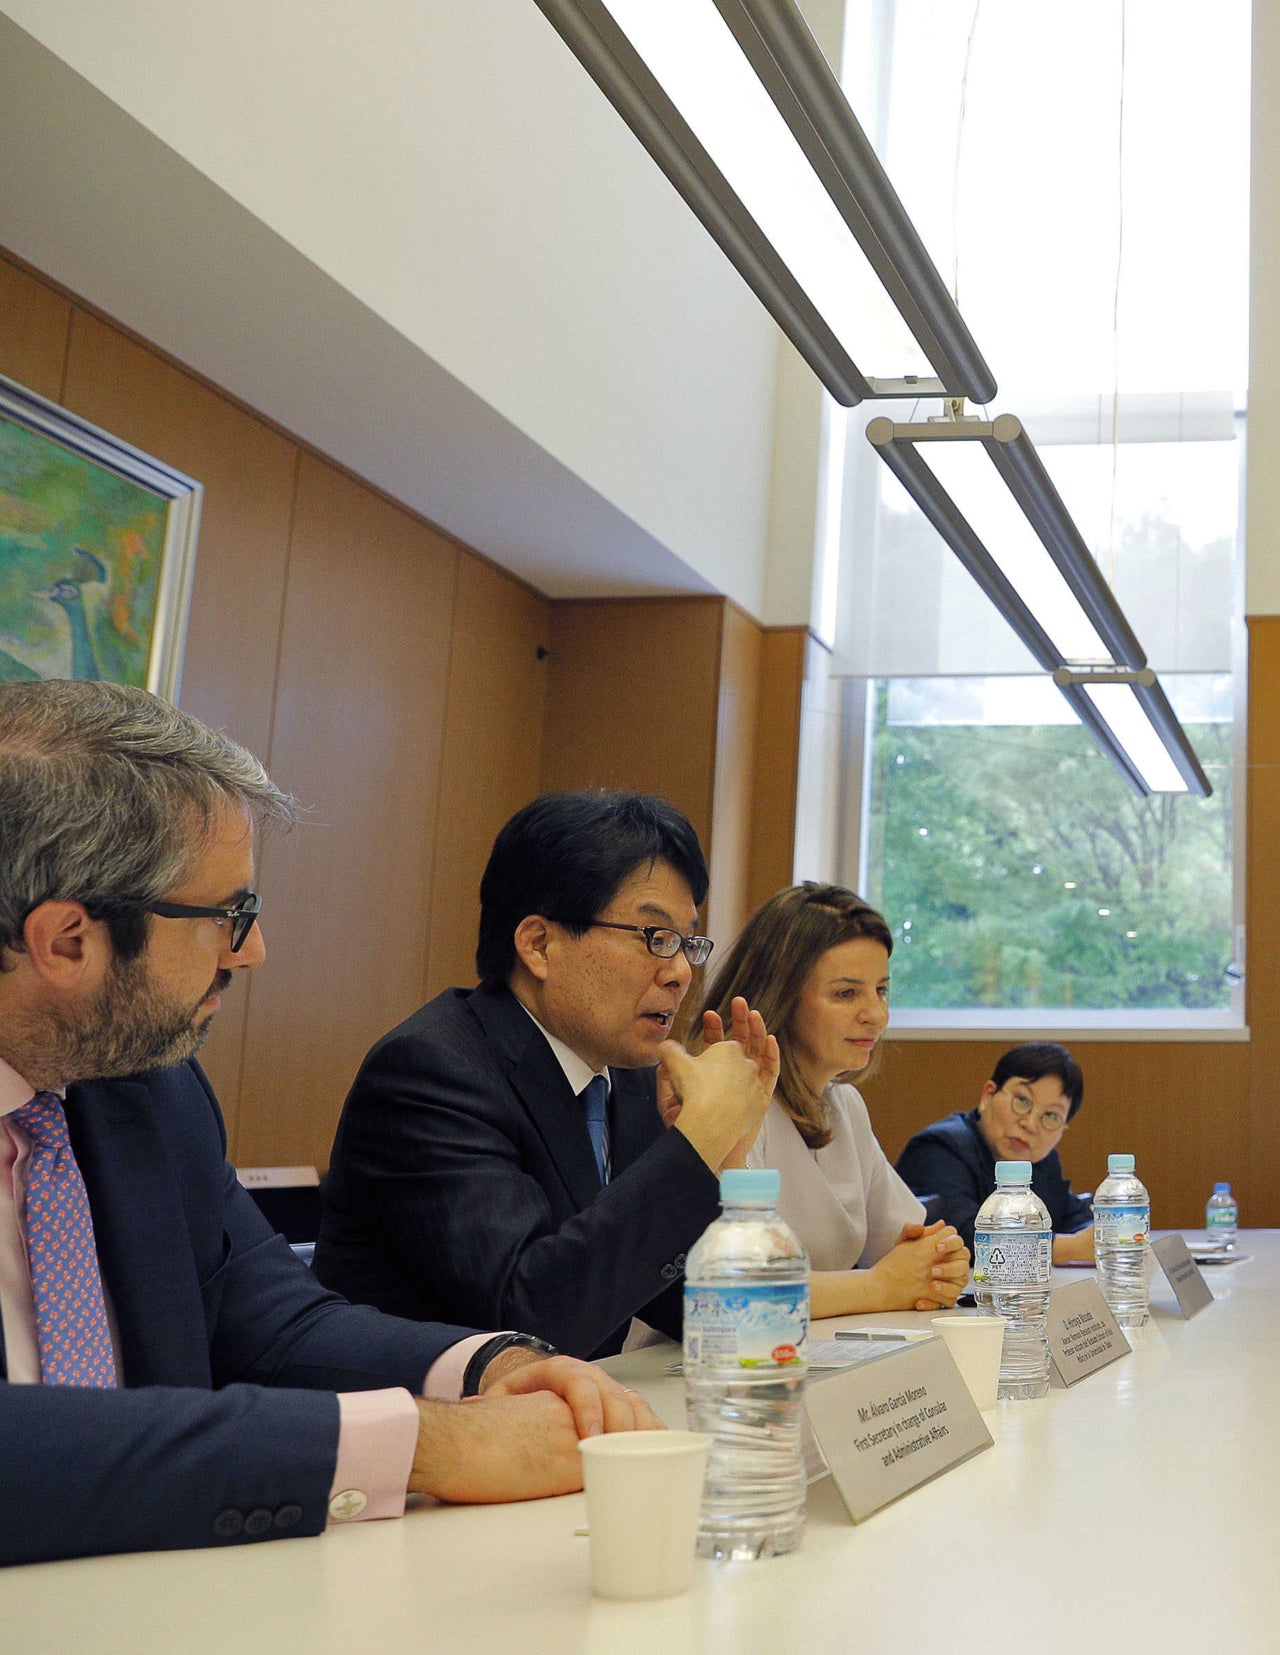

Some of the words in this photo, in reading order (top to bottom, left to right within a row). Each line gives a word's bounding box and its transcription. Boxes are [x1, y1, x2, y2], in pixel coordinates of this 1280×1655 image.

[853, 1438, 872, 1452] First
[867, 1425, 899, 1446] Secretary
[894, 1421, 904, 1433] in
[901, 1415, 922, 1429] charge
[918, 1408, 927, 1422] of
[923, 1400, 948, 1419] Consular
[857, 1406, 872, 1424] Mr.
[869, 1400, 890, 1419] Álvaro
[888, 1391, 908, 1410] García
[904, 1386, 928, 1403] Moreno
[881, 1450, 896, 1467] and
[891, 1434, 932, 1461] Administrative
[928, 1425, 950, 1441] Affairs
